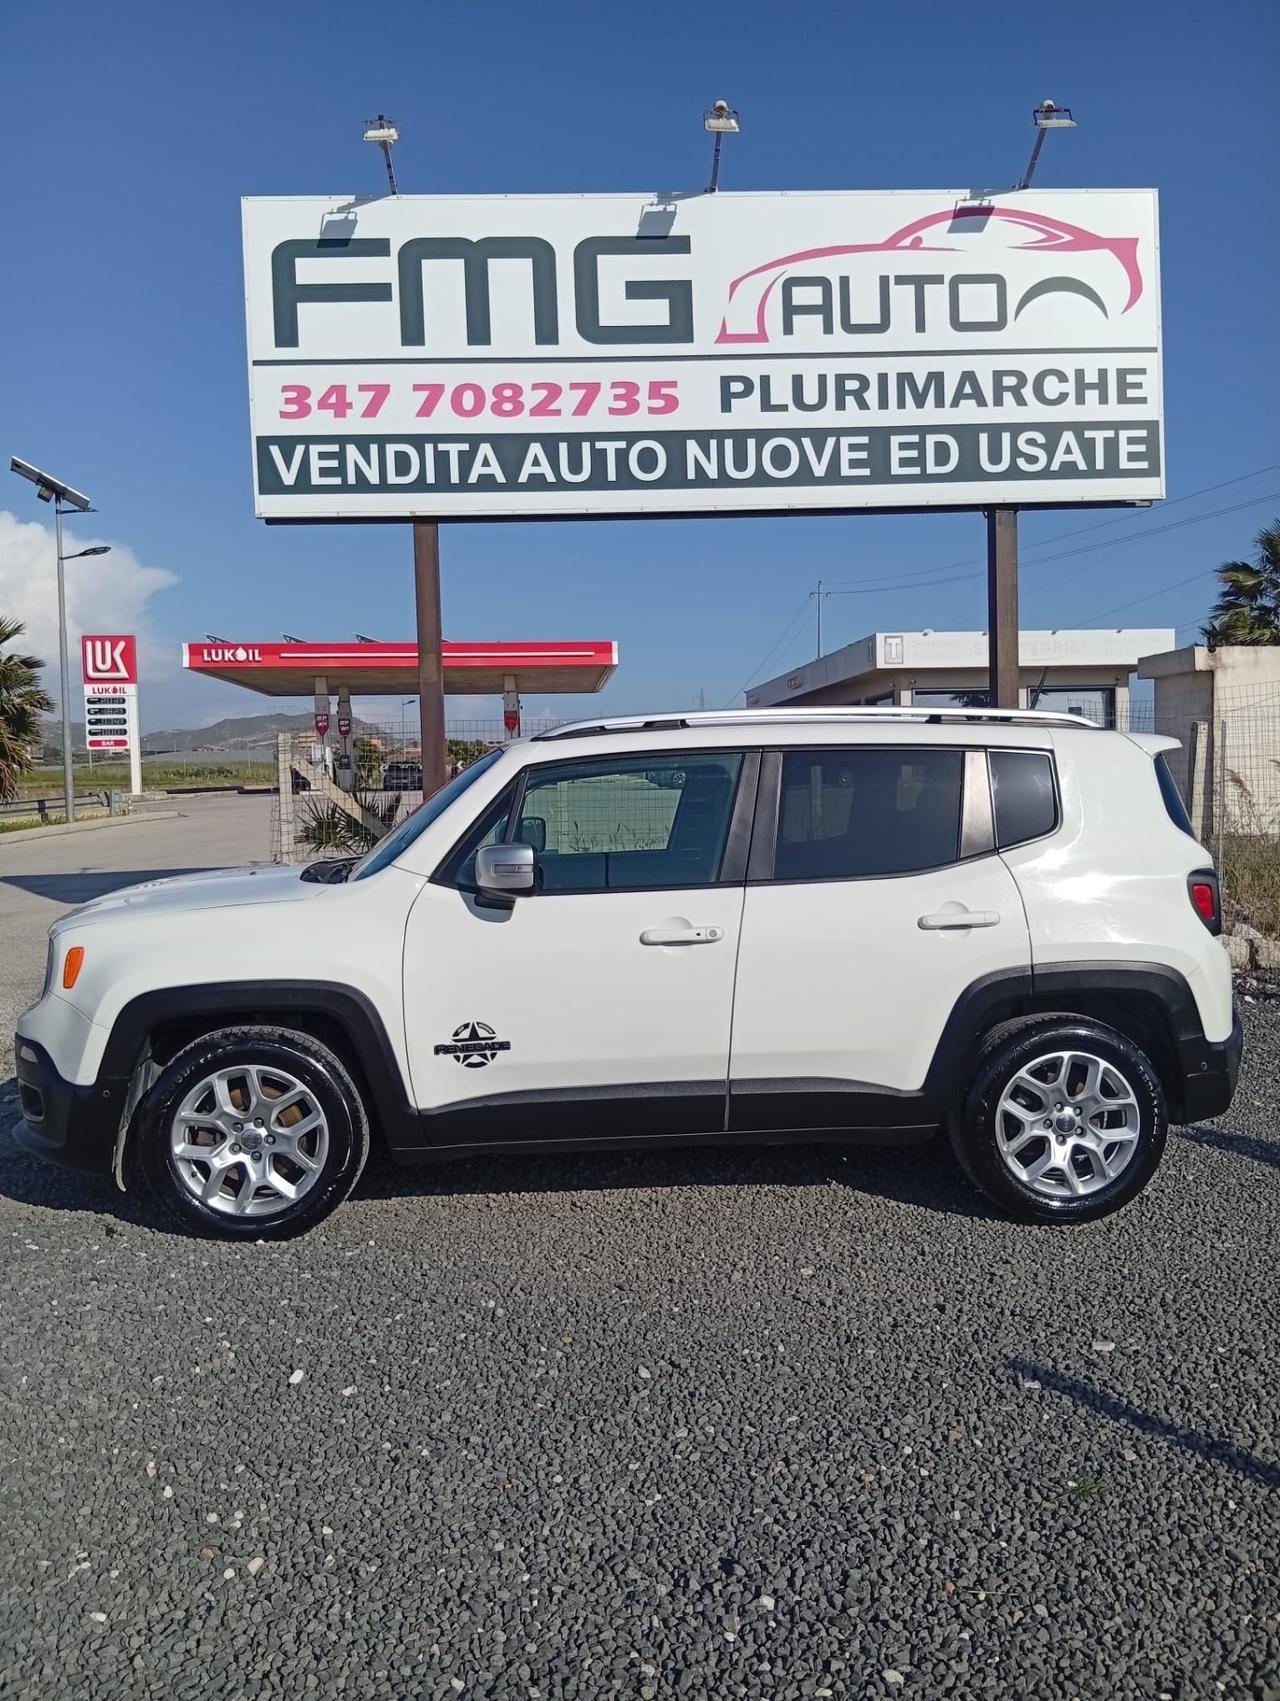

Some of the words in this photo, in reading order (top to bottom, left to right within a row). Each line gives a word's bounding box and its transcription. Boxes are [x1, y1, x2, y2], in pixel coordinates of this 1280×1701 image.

[271, 235, 695, 348] FMG
[782, 273, 1007, 335] AUTO
[281, 384, 389, 419] 347
[415, 381, 678, 417] 7082735
[721, 369, 1148, 414] PLURIMARCHE
[269, 443, 506, 485] VENDITA
[518, 440, 666, 482] AUTO
[686, 436, 871, 480] NUOVE
[890, 434, 959, 475] ED
[978, 429, 1149, 473] USATE
[203, 647, 262, 662] LUKOIL
[434, 1041, 511, 1055] RENEGADE
